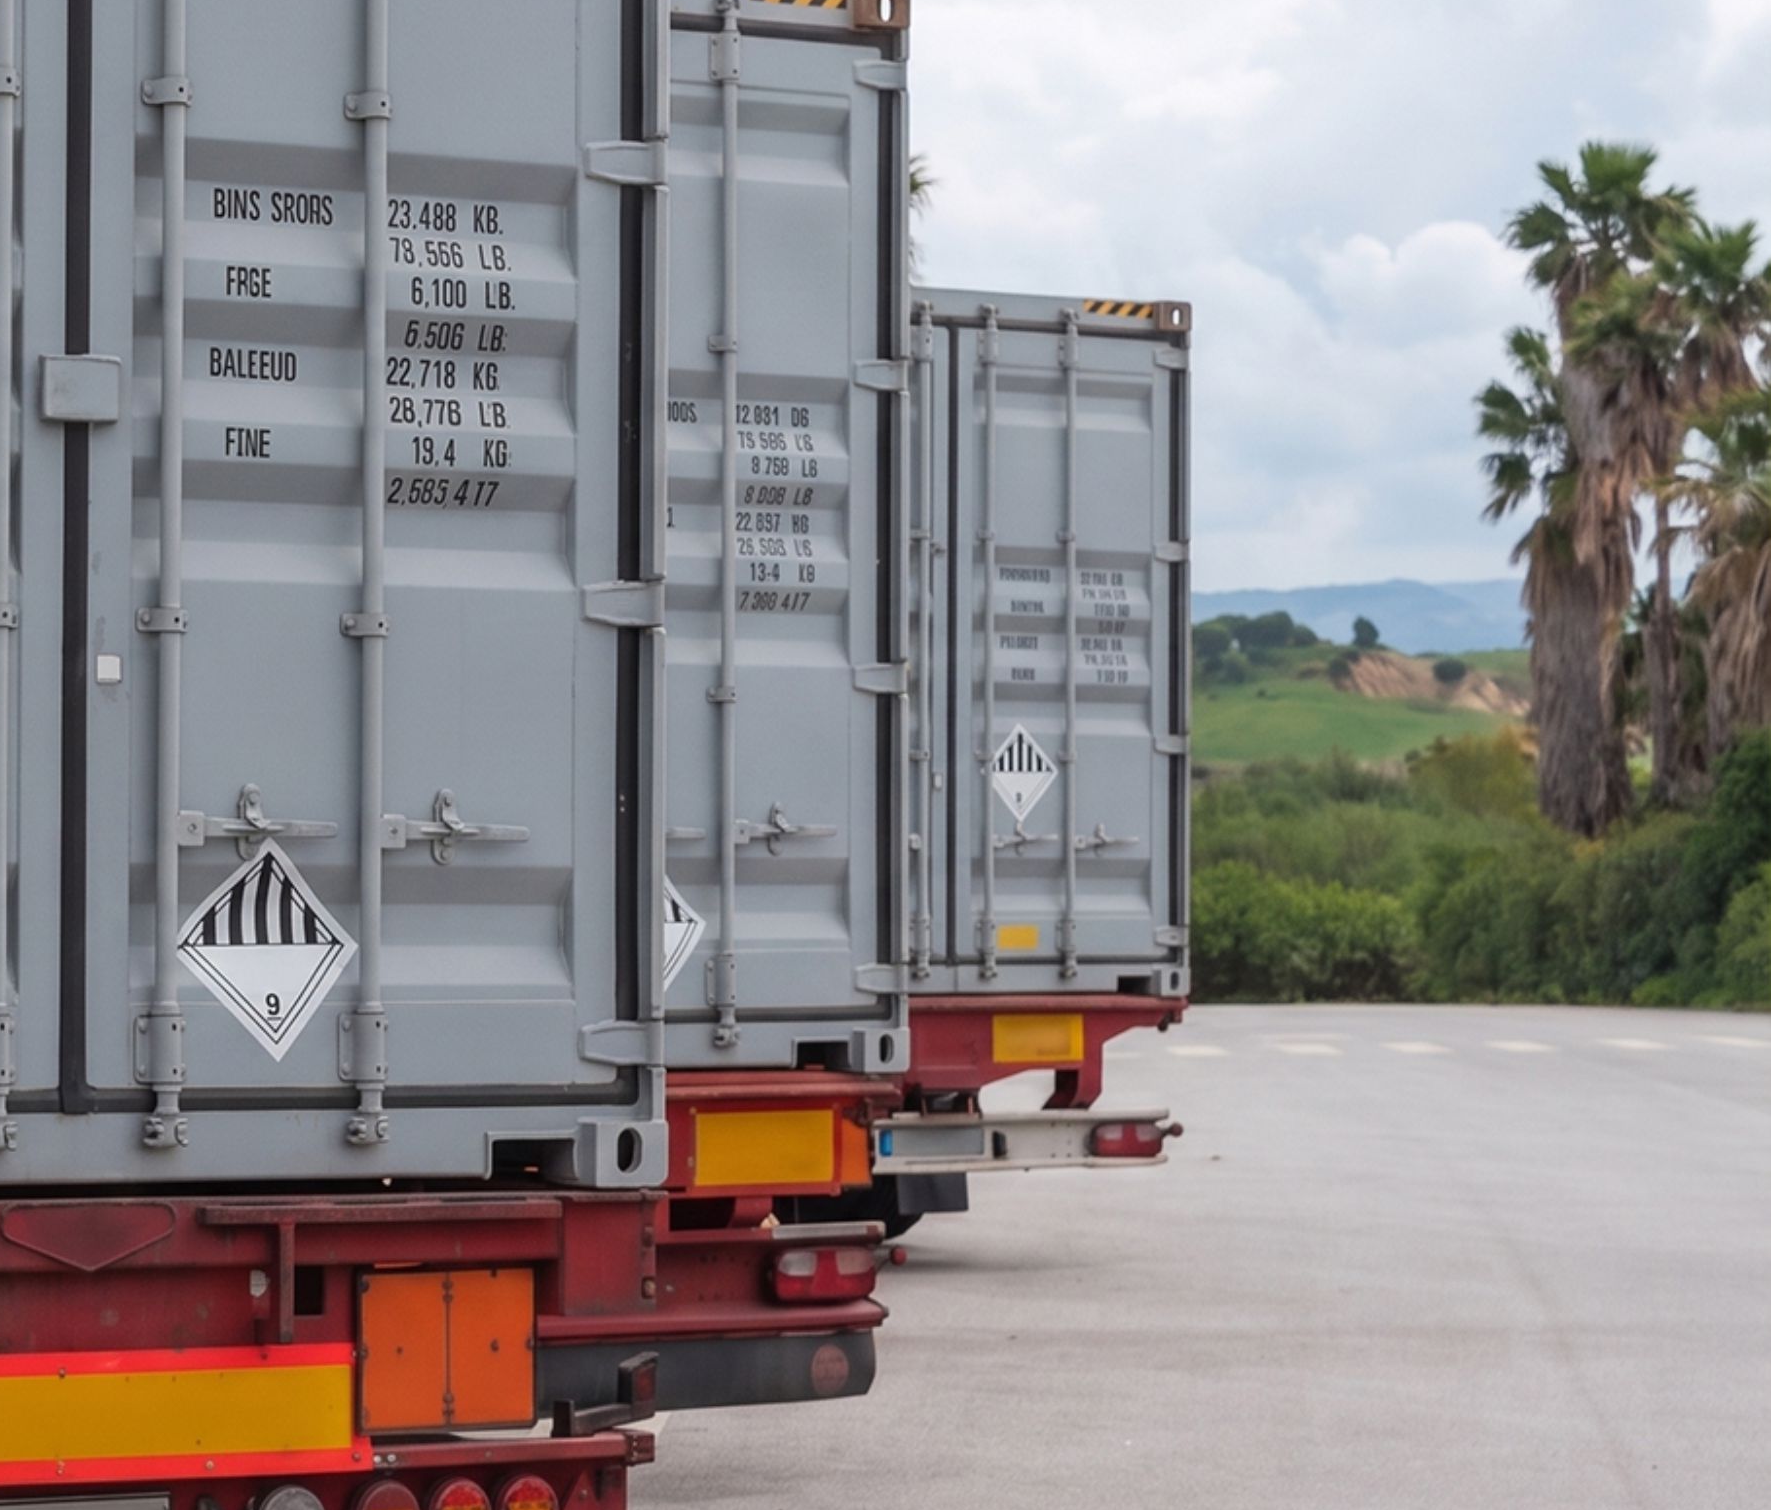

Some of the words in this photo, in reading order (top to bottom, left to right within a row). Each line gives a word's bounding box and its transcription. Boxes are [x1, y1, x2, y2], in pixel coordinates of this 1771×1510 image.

[214, 188, 260, 221] BINS
[209, 348, 297, 382] BALEEUD
[225, 427, 271, 459] FINE
[264, 992, 281, 1017] 9
